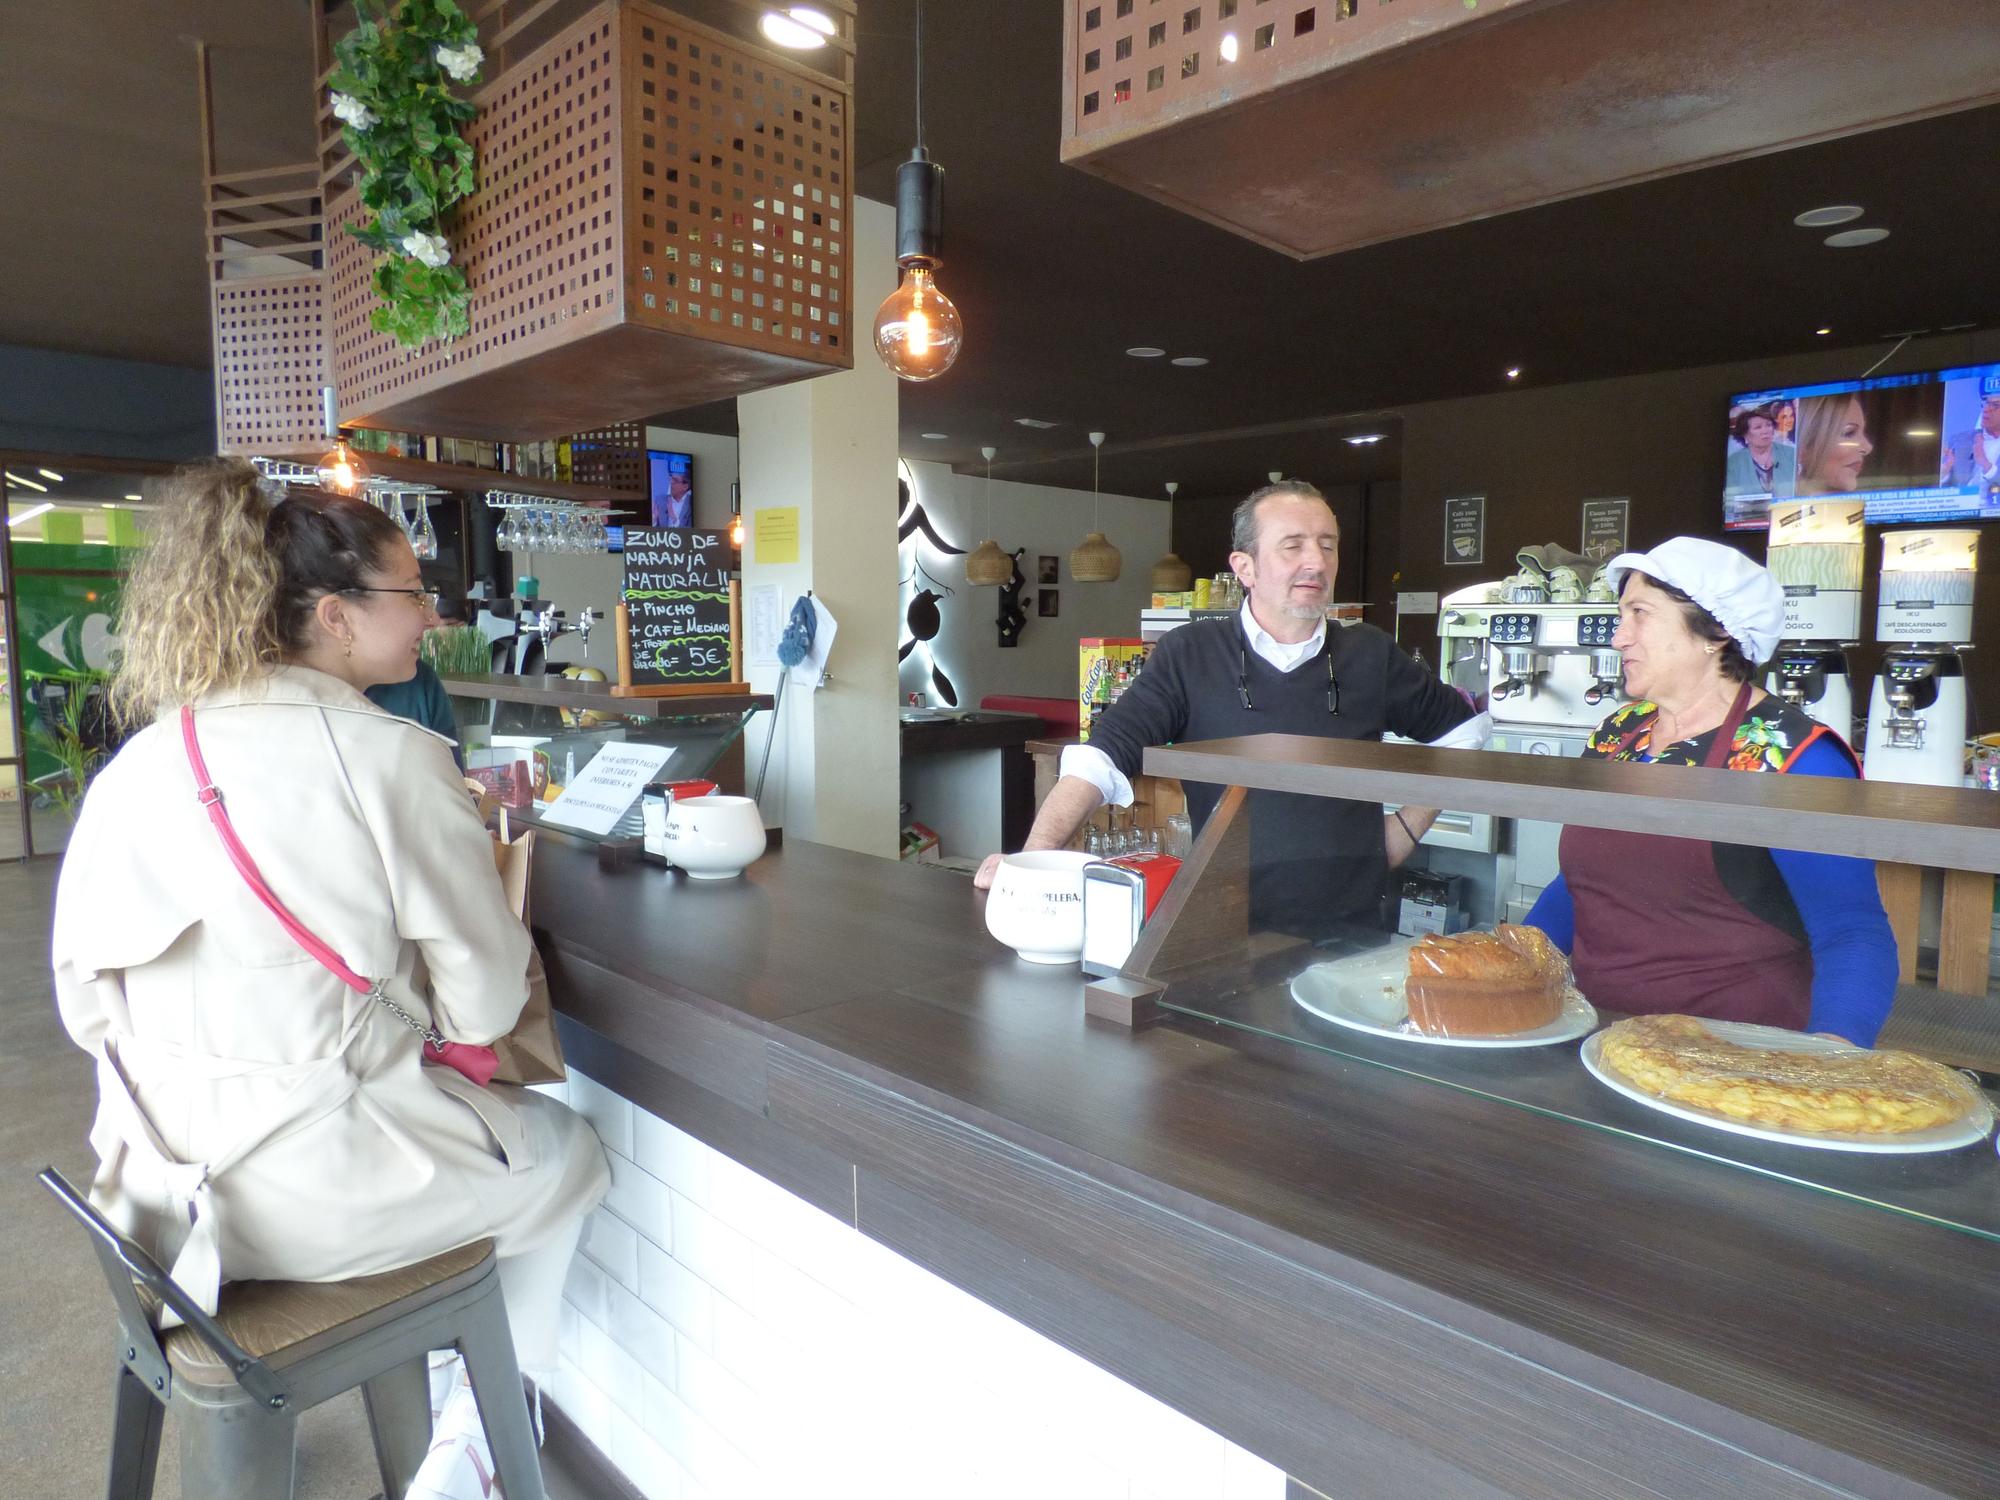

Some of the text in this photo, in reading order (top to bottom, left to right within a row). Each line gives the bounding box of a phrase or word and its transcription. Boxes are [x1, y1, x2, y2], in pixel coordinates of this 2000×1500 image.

[626, 531, 682, 548] ZUMO
[692, 534, 719, 549] DE
[628, 604, 640, 618] +
[629, 625, 640, 637] +
[632, 642, 640, 650] +
[689, 647, 721, 666] 5€
